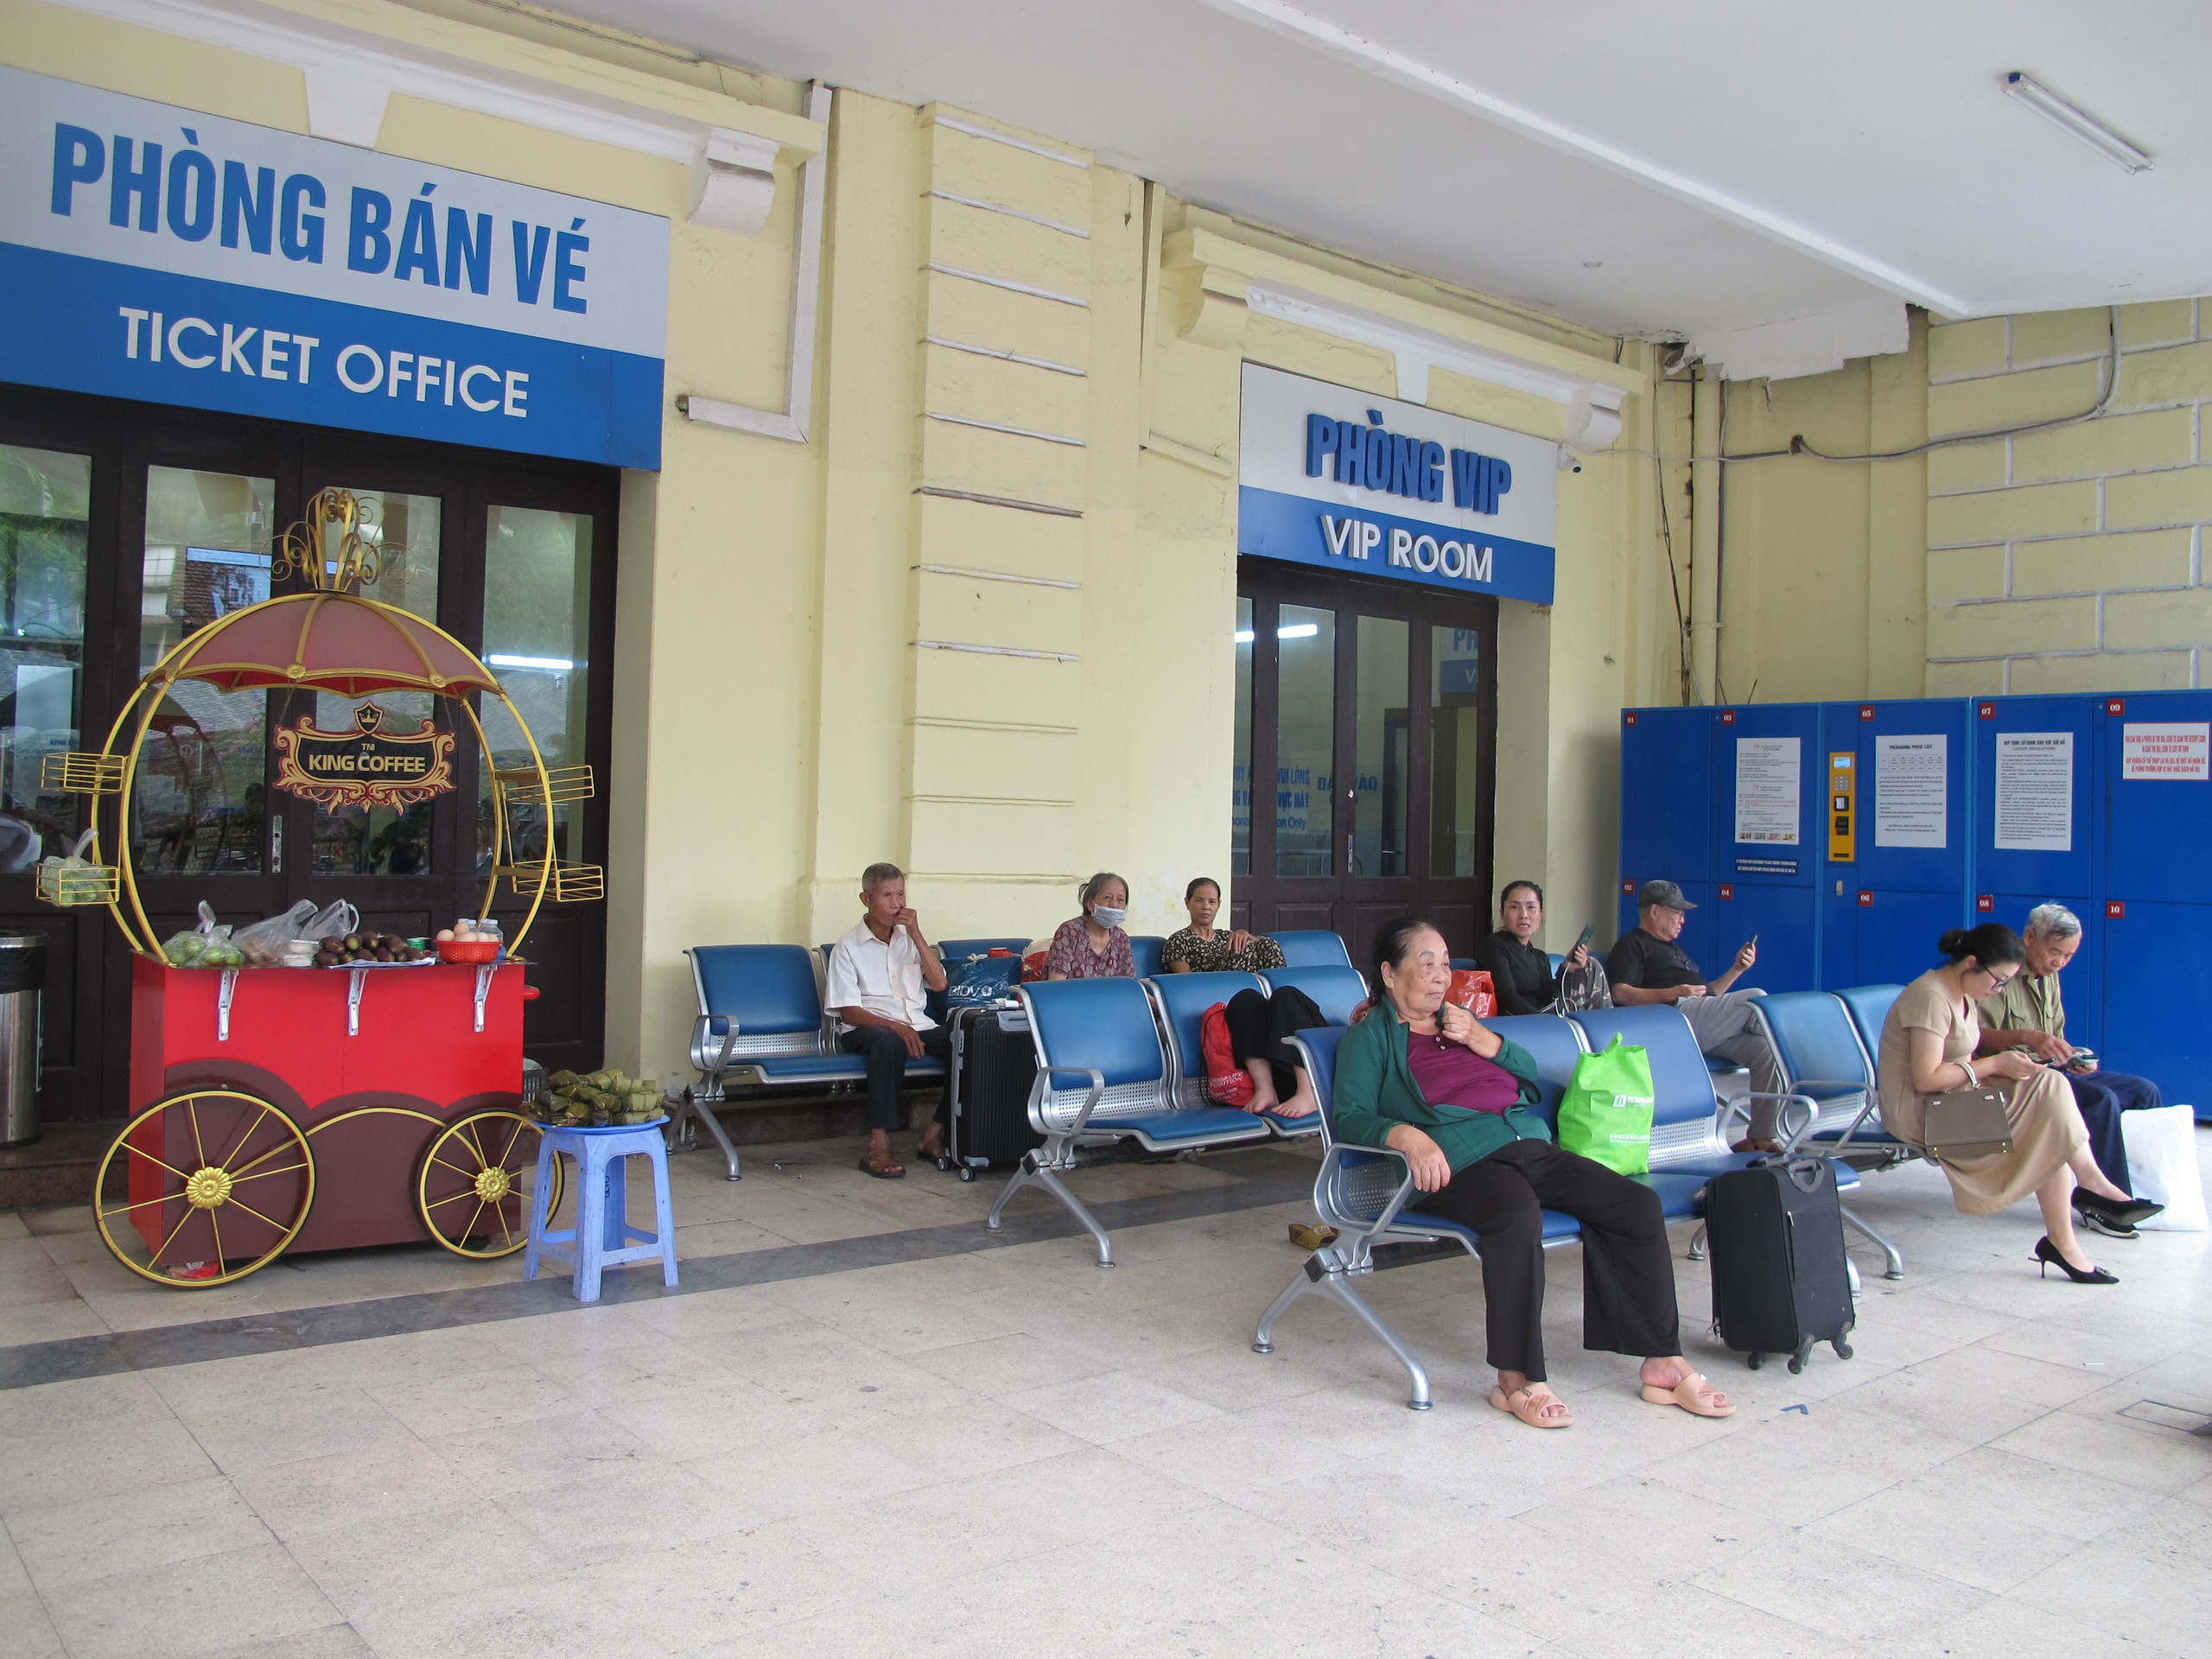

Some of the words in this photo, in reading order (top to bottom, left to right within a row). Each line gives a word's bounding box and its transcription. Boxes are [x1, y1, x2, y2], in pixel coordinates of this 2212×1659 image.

[51, 122, 327, 265] PHÒNG
[347, 182, 493, 296] BÁN
[512, 217, 590, 315] VÉ
[119, 307, 320, 385] TICKET
[337, 344, 530, 418] OFFICE
[1306, 409, 1446, 503] PHÒNG
[1451, 448, 1512, 516] VIP
[1320, 515, 1382, 561] VIP
[1389, 528, 1493, 583] ROOM
[1861, 709, 1872, 718] 05
[1981, 707, 1992, 715] 07
[2109, 703, 2120, 712] 09
[1723, 714, 1732, 722] 03
[308, 754, 355, 771] KING
[358, 755, 426, 772] COFFEE
[1287, 816, 1306, 831] Only
[2110, 905, 2120, 913] 10
[948, 985, 982, 997] BIDV
